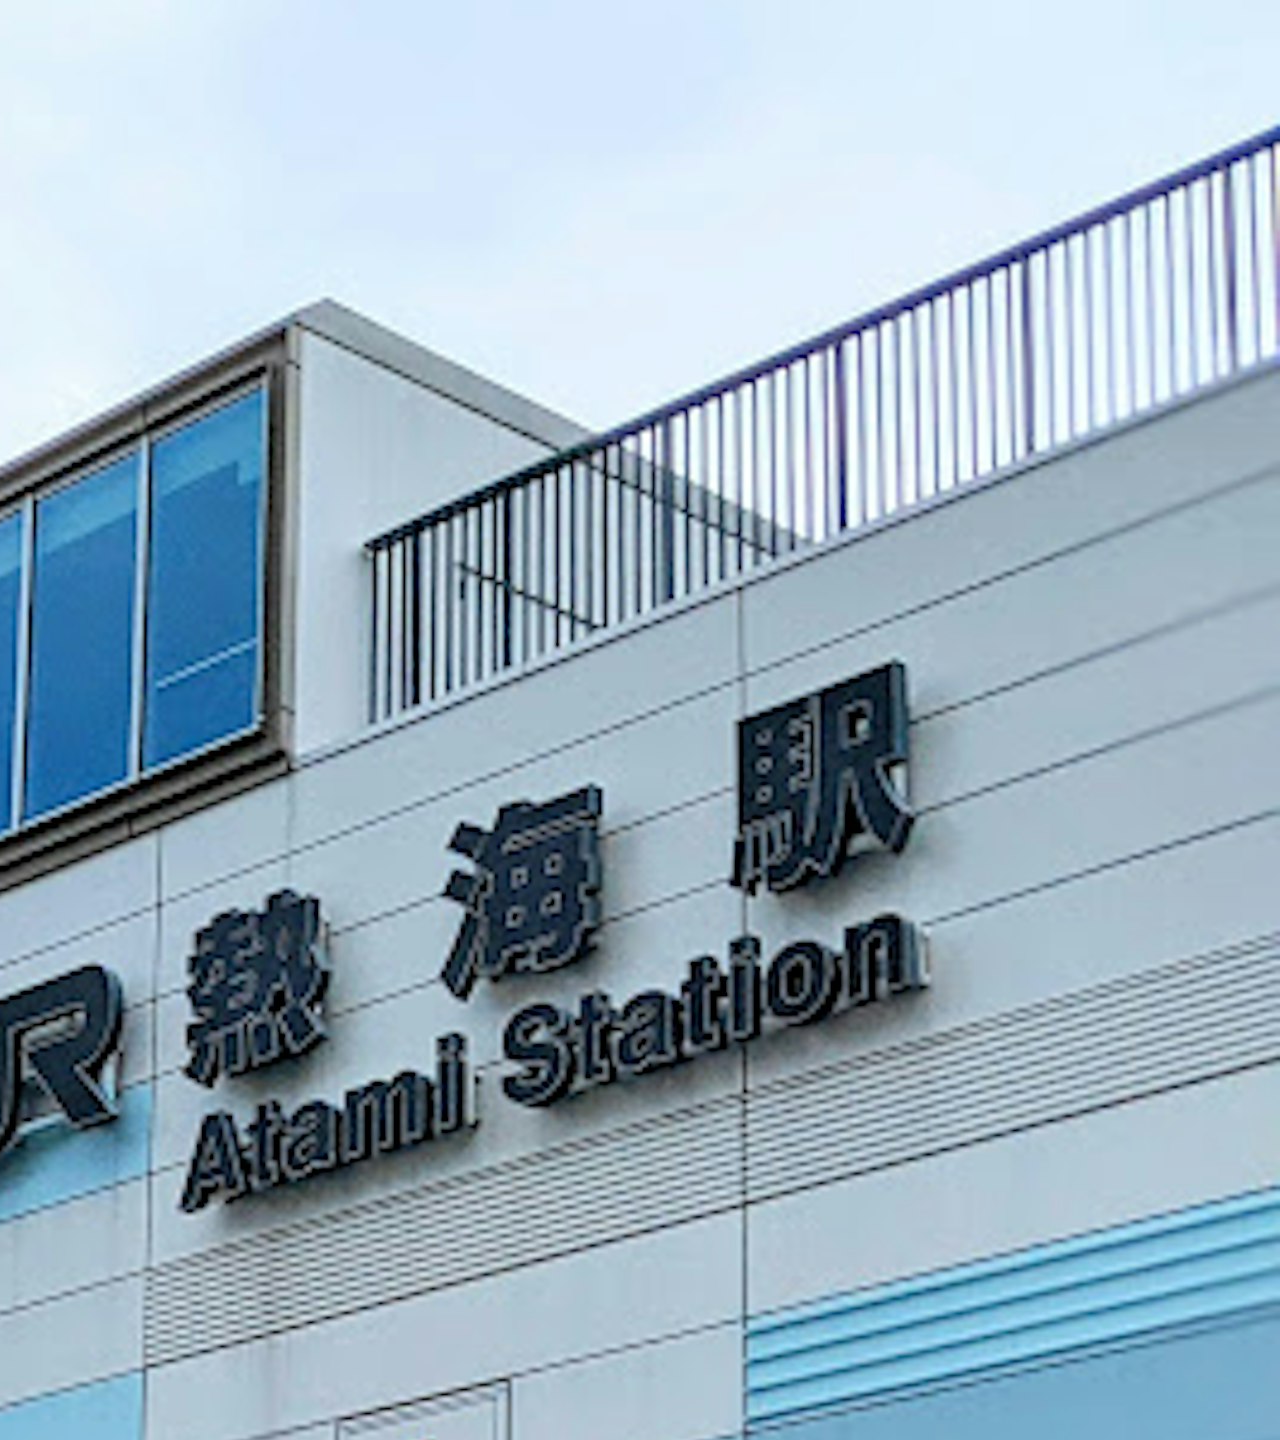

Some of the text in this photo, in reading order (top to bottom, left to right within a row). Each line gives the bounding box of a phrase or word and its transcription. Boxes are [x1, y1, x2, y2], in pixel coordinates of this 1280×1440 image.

[182, 659, 916, 1088] 熱海駅
[179, 914, 930, 1212] Atami Station
